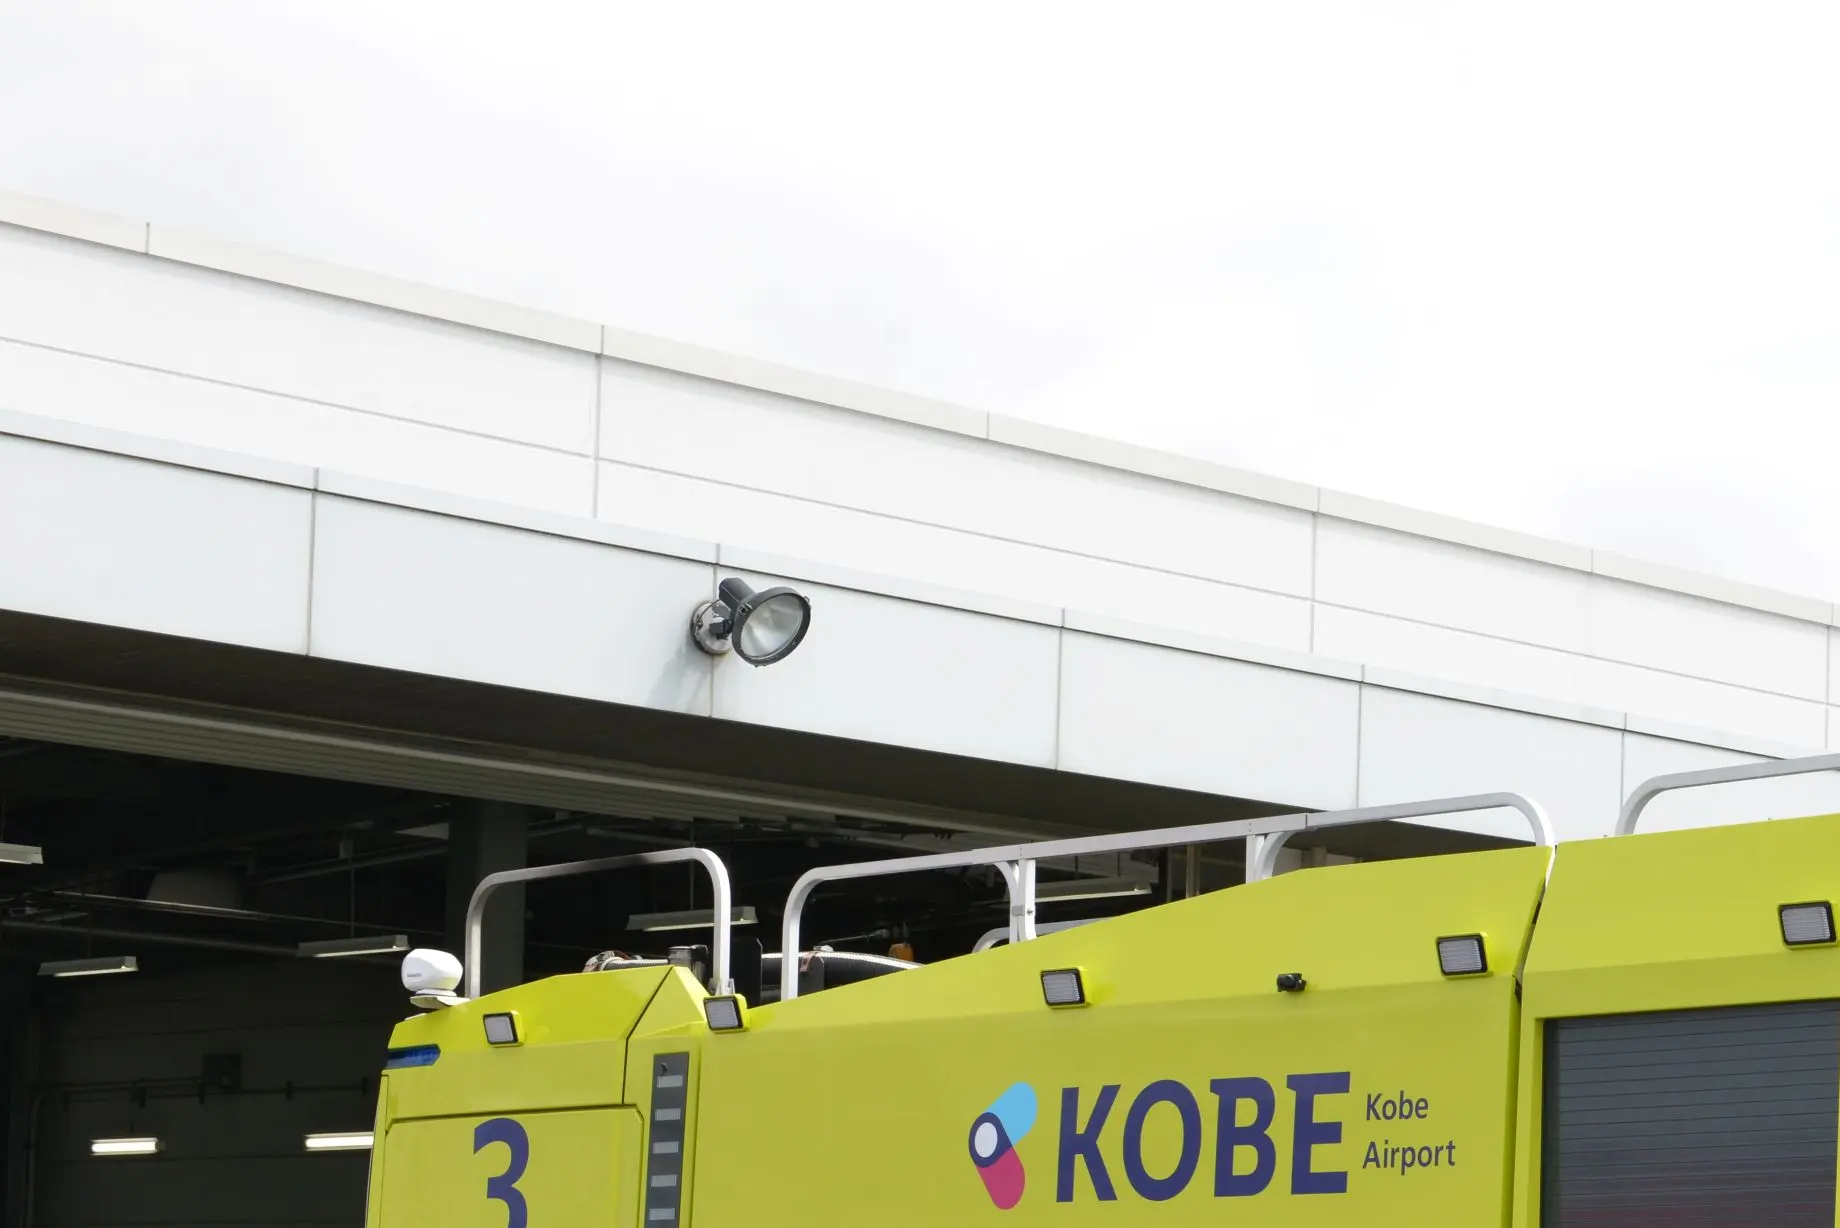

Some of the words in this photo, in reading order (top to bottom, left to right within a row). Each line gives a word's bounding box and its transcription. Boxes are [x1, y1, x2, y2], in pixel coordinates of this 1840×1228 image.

[1365, 1090, 1429, 1122] Kobe
[1057, 1072, 1350, 1203] KOBE
[1362, 1139, 1457, 1176] Airport
